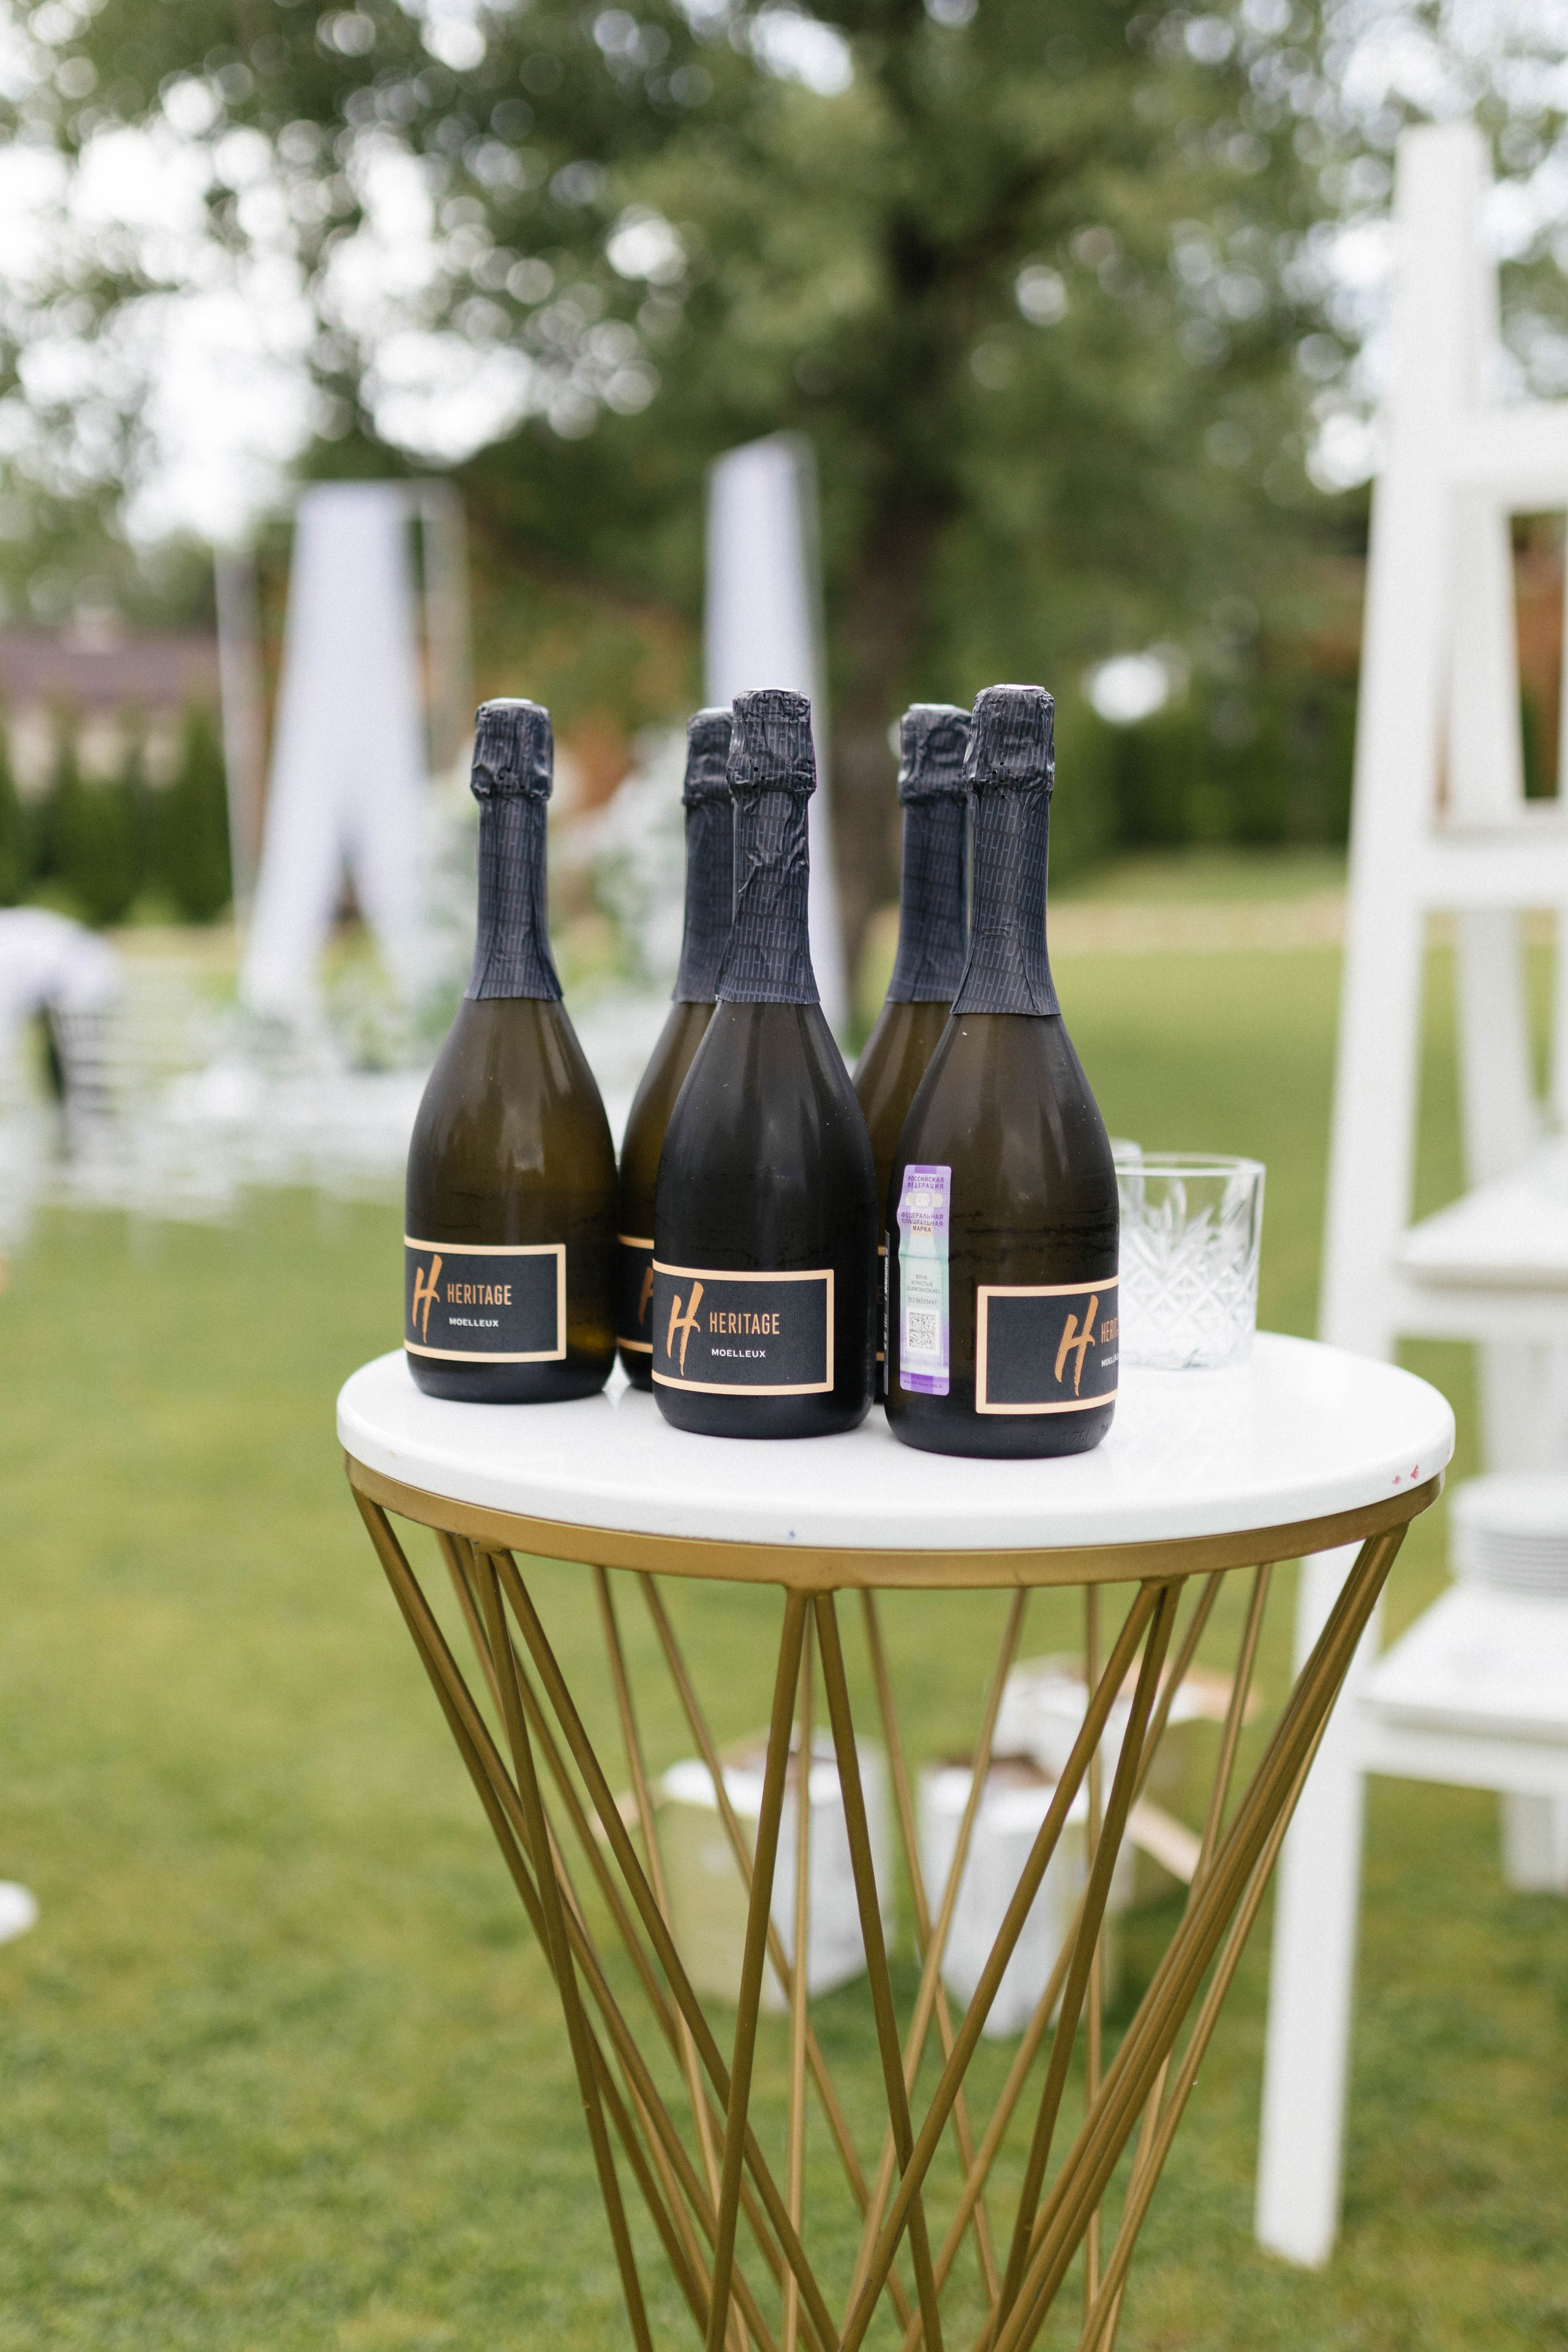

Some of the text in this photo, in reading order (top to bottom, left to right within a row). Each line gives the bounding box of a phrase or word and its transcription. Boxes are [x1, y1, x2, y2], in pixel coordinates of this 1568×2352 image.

[902, 1212, 943, 1220] ФЕДЕРАЛЬНАЯ
[902, 1218, 943, 1227] СПЕЦИАЛЬНАЯ
[447, 1283, 512, 1306] HERITAGE
[448, 1317, 499, 1328] MOELLEUX
[709, 1311, 780, 1335] HERITAGE
[711, 1348, 766, 1359] MOELLEUX
